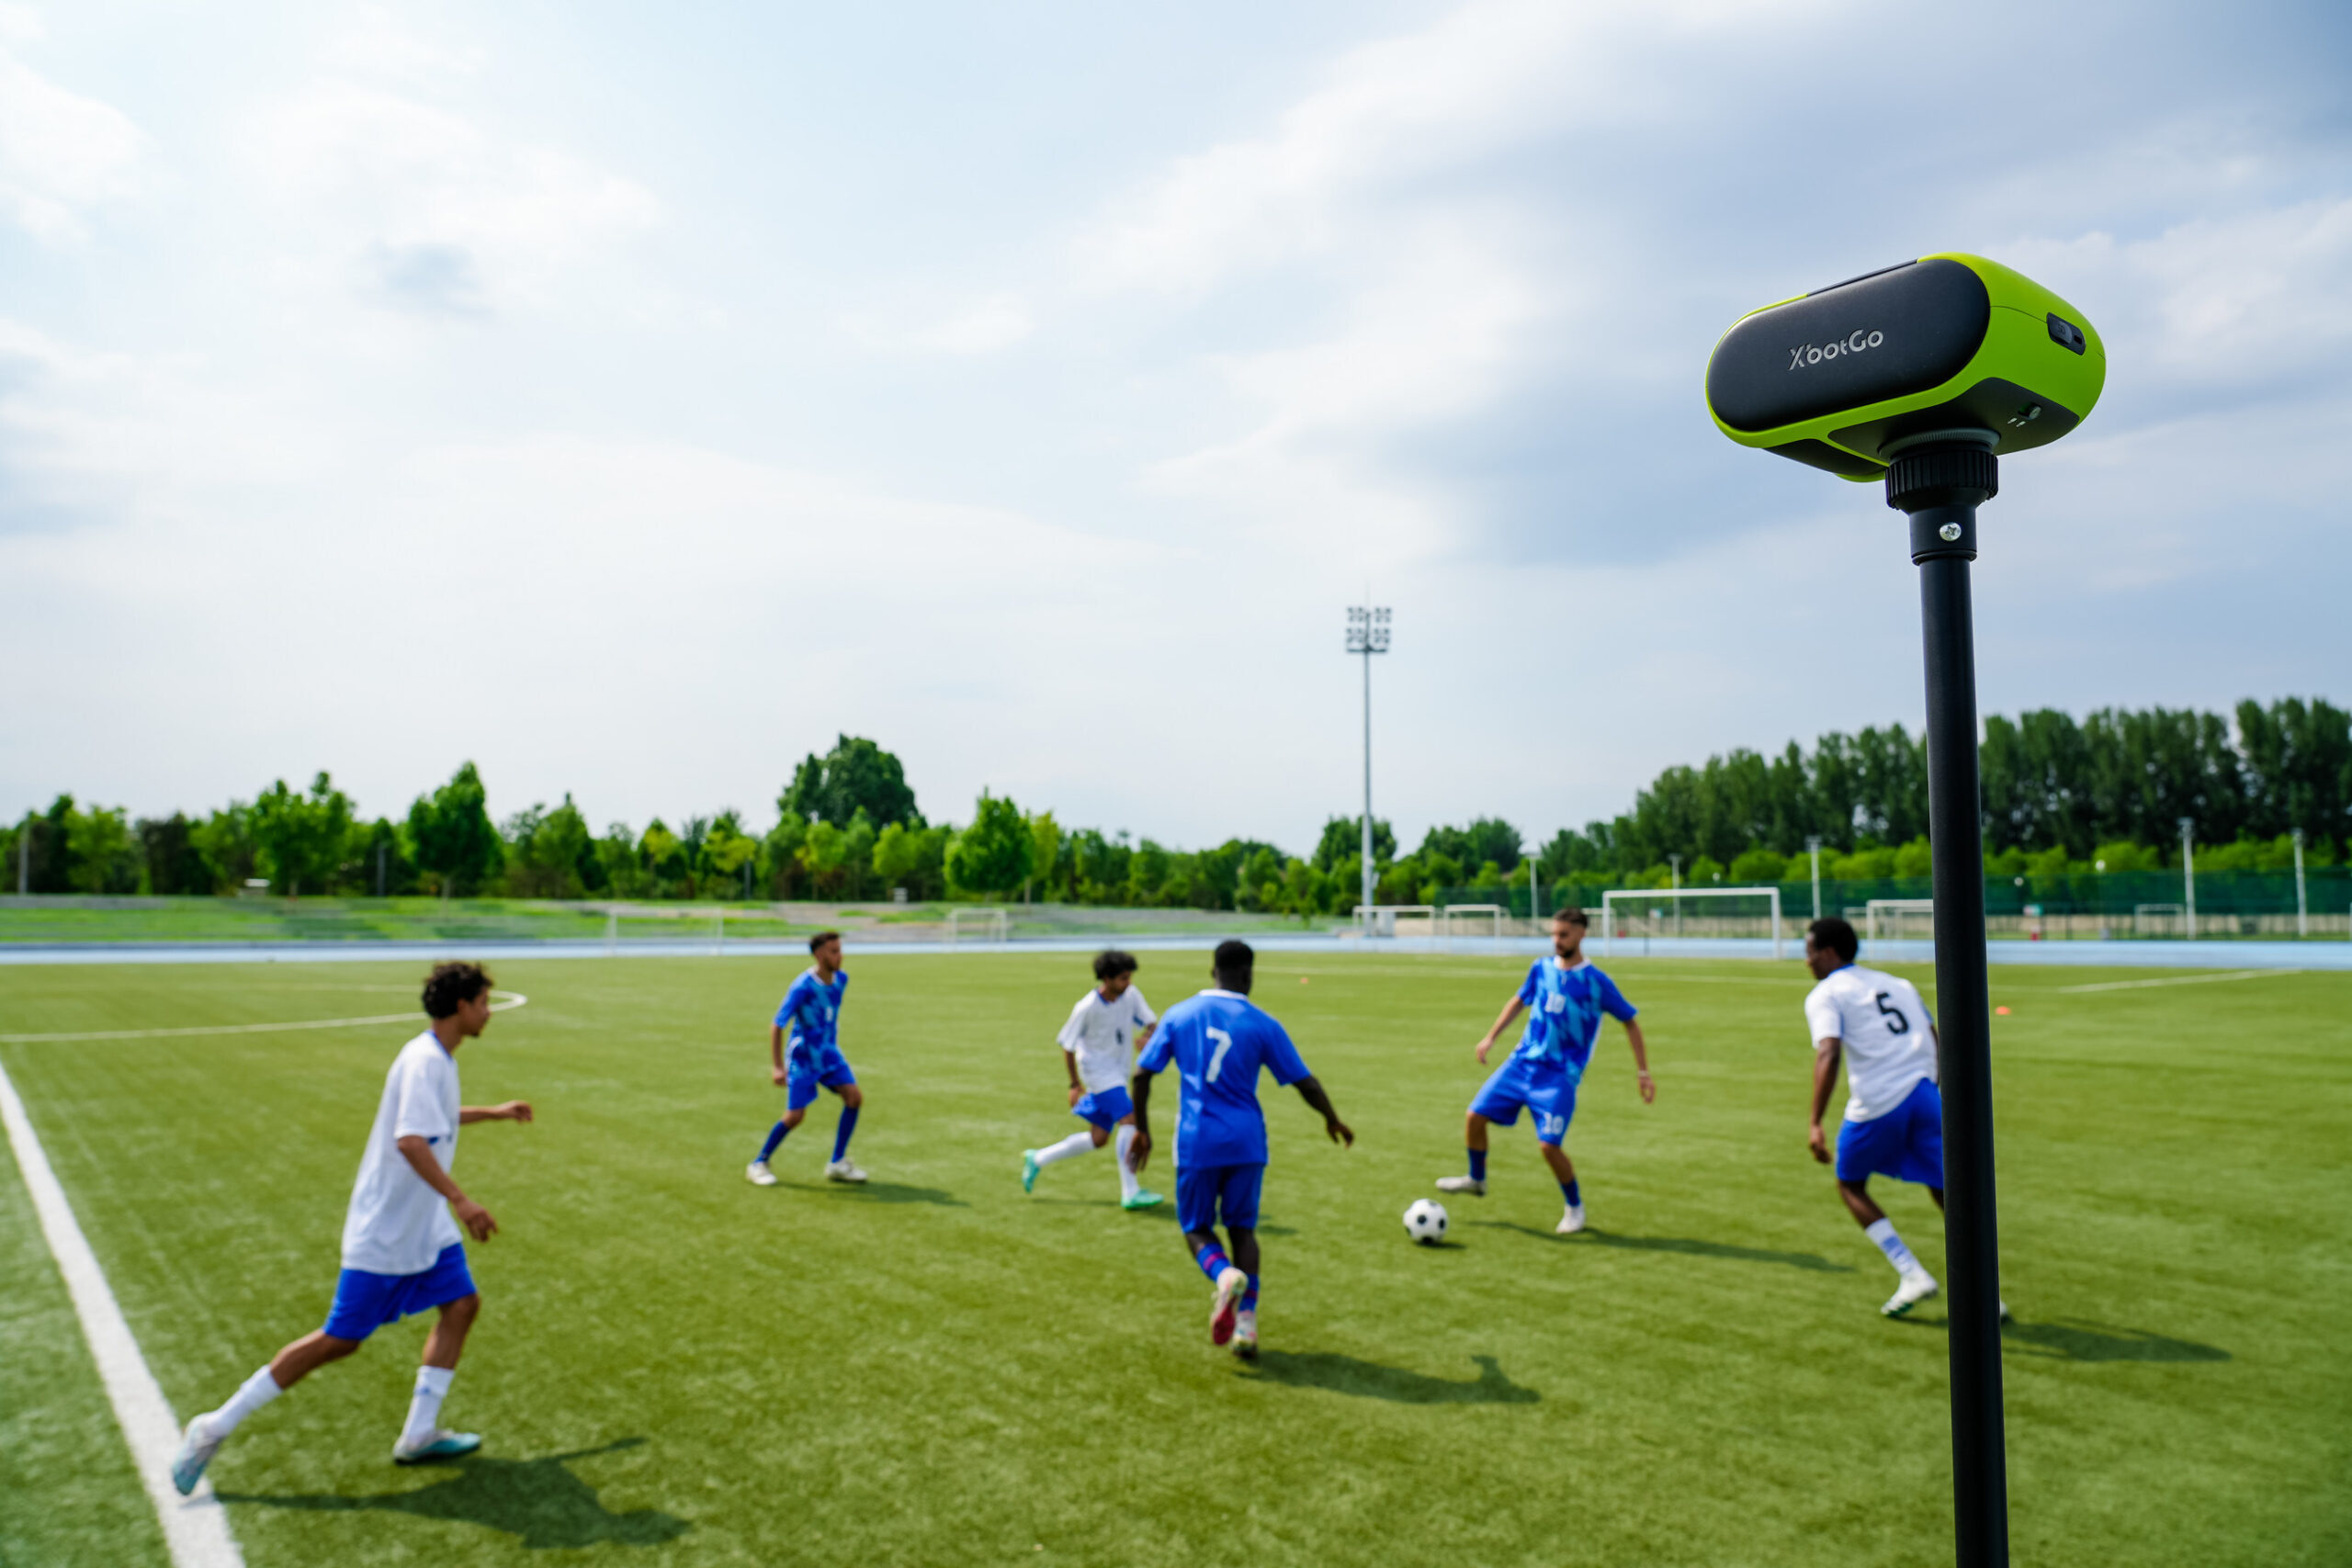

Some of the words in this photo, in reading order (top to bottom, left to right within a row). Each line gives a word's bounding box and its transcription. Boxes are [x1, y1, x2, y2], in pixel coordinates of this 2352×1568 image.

[1789, 330, 1883, 370] XbotGo
[1876, 992, 1909, 1035] 5
[1206, 1027, 1232, 1083] 7
